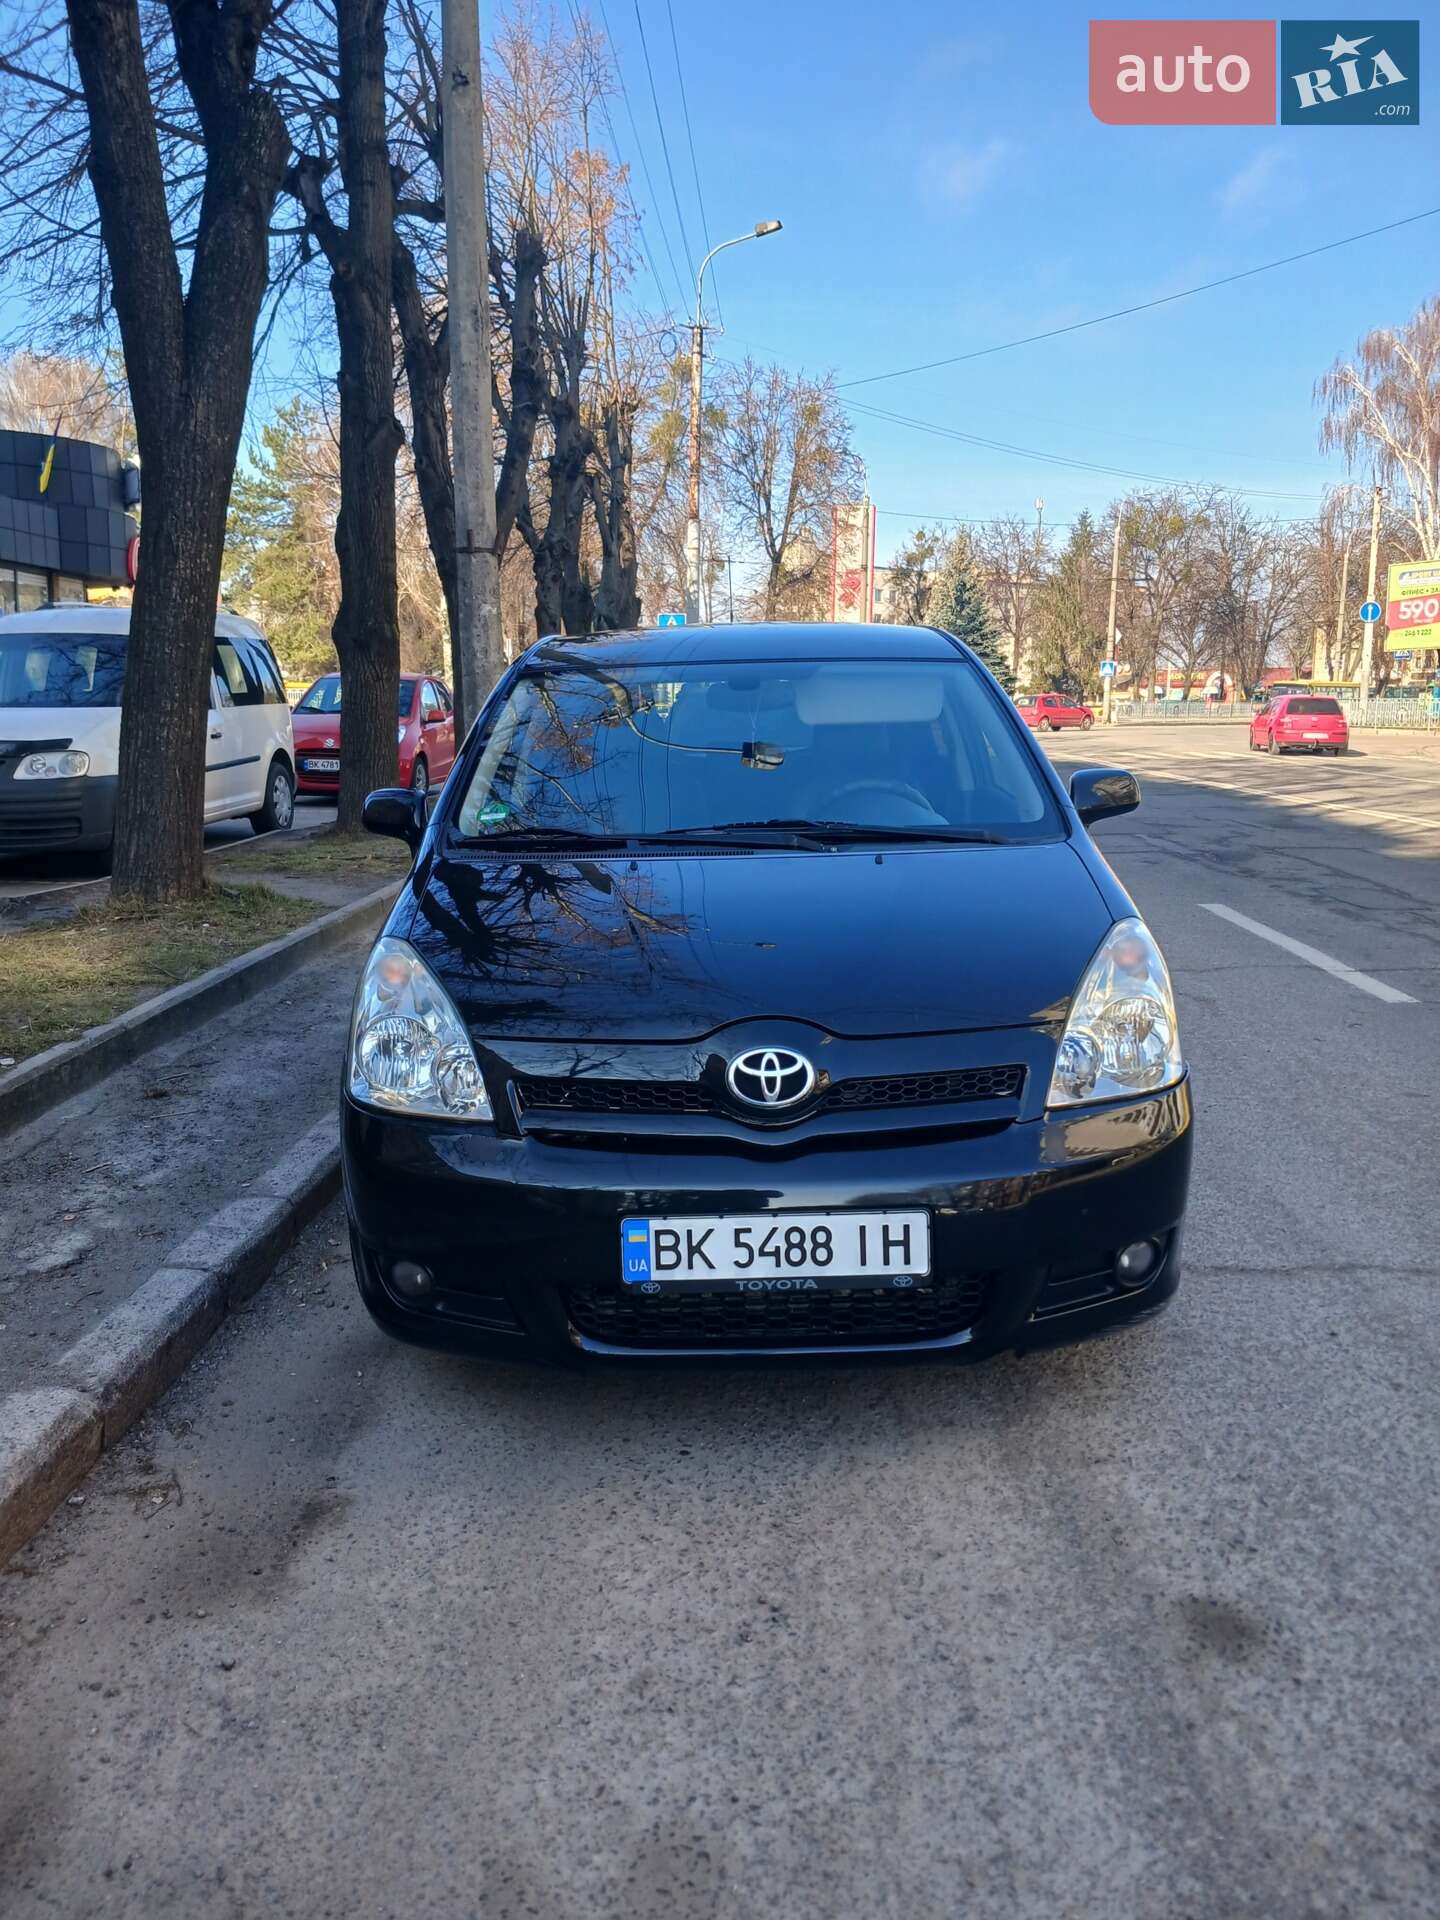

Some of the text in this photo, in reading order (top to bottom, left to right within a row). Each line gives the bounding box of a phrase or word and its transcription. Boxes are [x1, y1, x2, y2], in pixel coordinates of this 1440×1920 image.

[1398, 598, 1440, 620] 590
[308, 760, 320, 769] BK
[653, 1223, 911, 1271] BK 5488 IH
[628, 1259, 649, 1273] UA
[735, 1278, 819, 1292] TOYOTA
